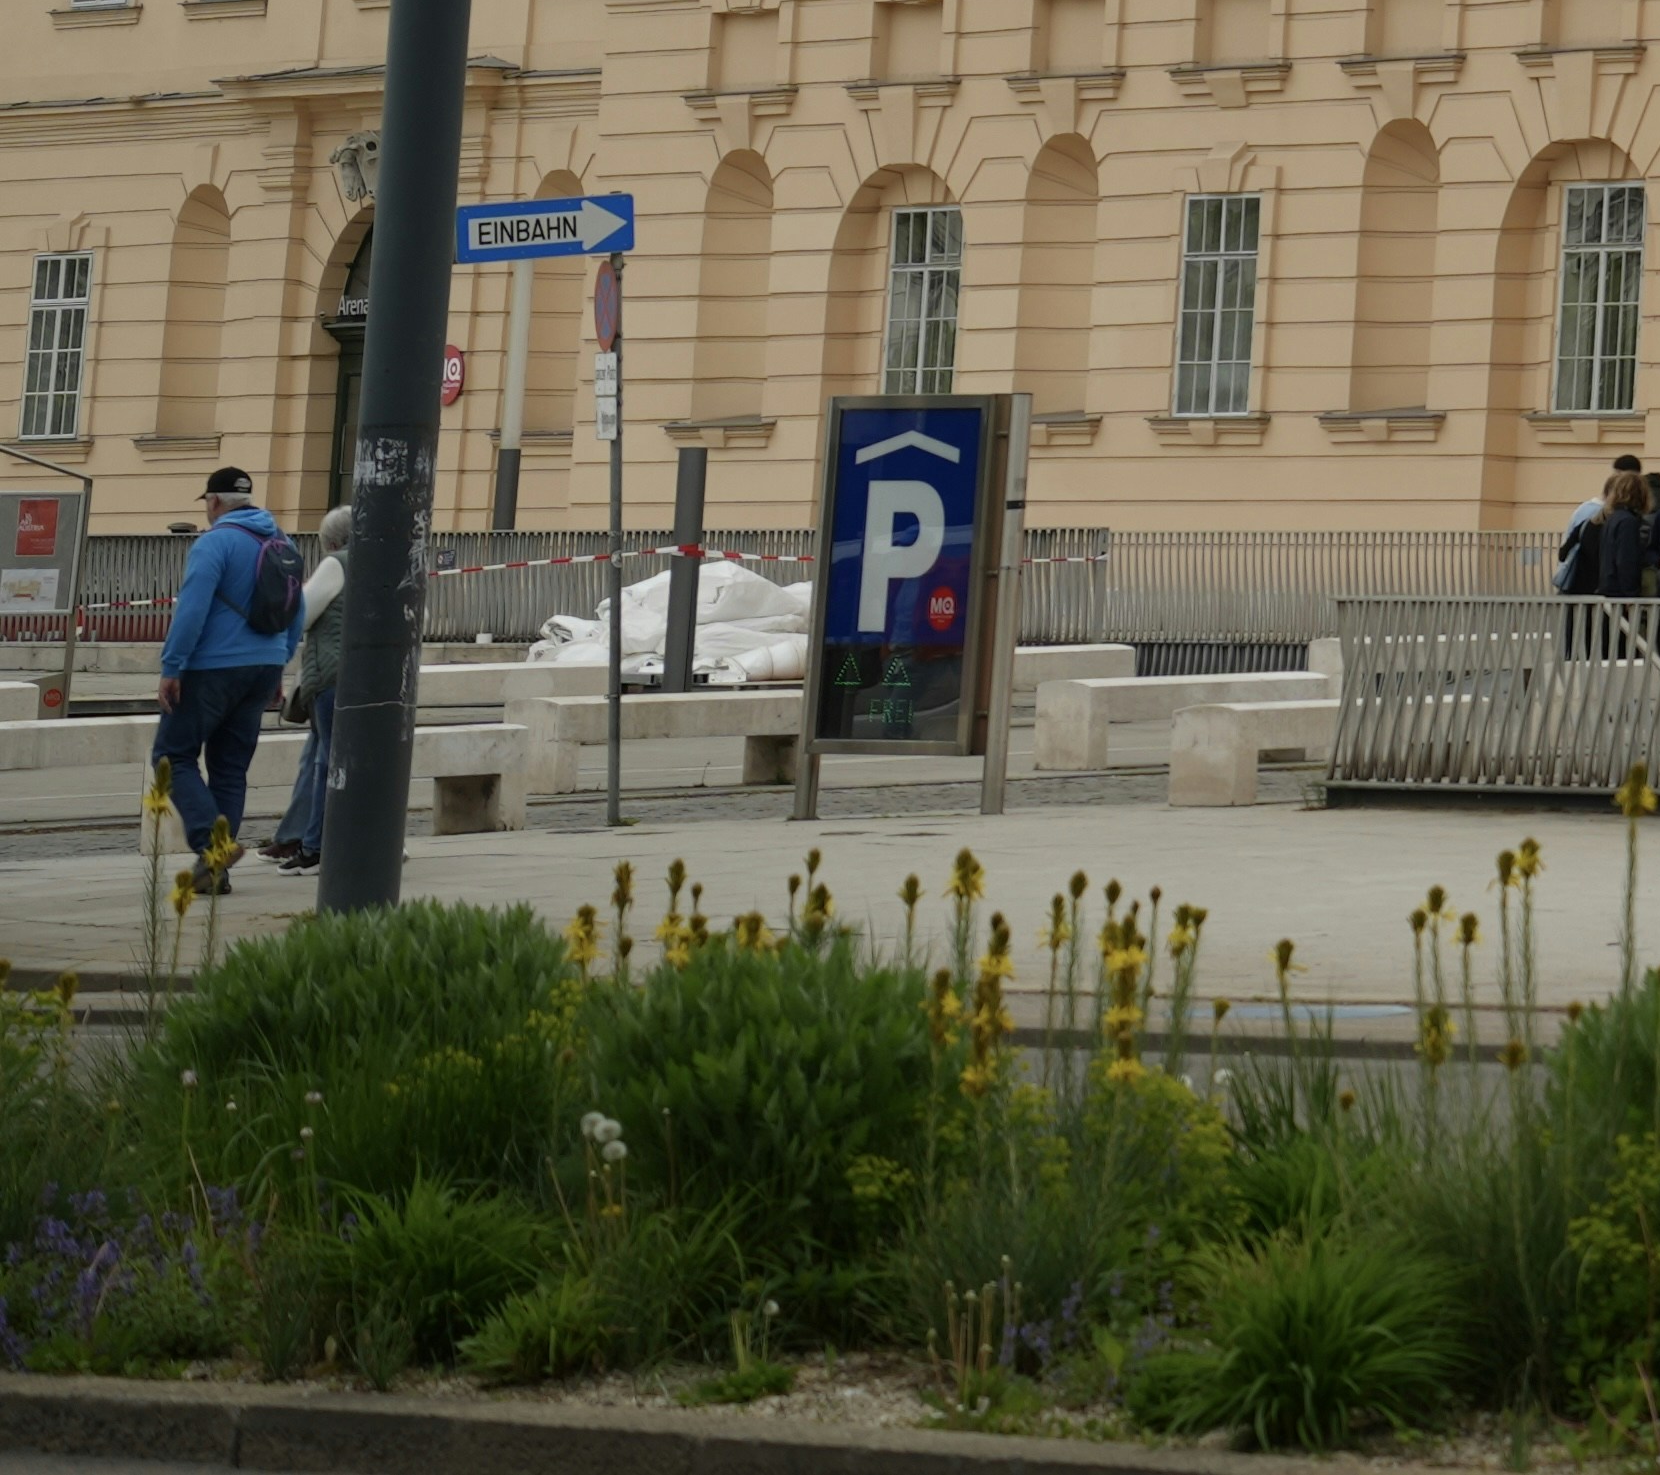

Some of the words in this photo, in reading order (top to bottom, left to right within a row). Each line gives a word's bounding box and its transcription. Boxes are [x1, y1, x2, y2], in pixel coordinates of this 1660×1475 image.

[477, 214, 579, 248] EINBAHN
[857, 479, 946, 634] P
[929, 596, 955, 615] MQ
